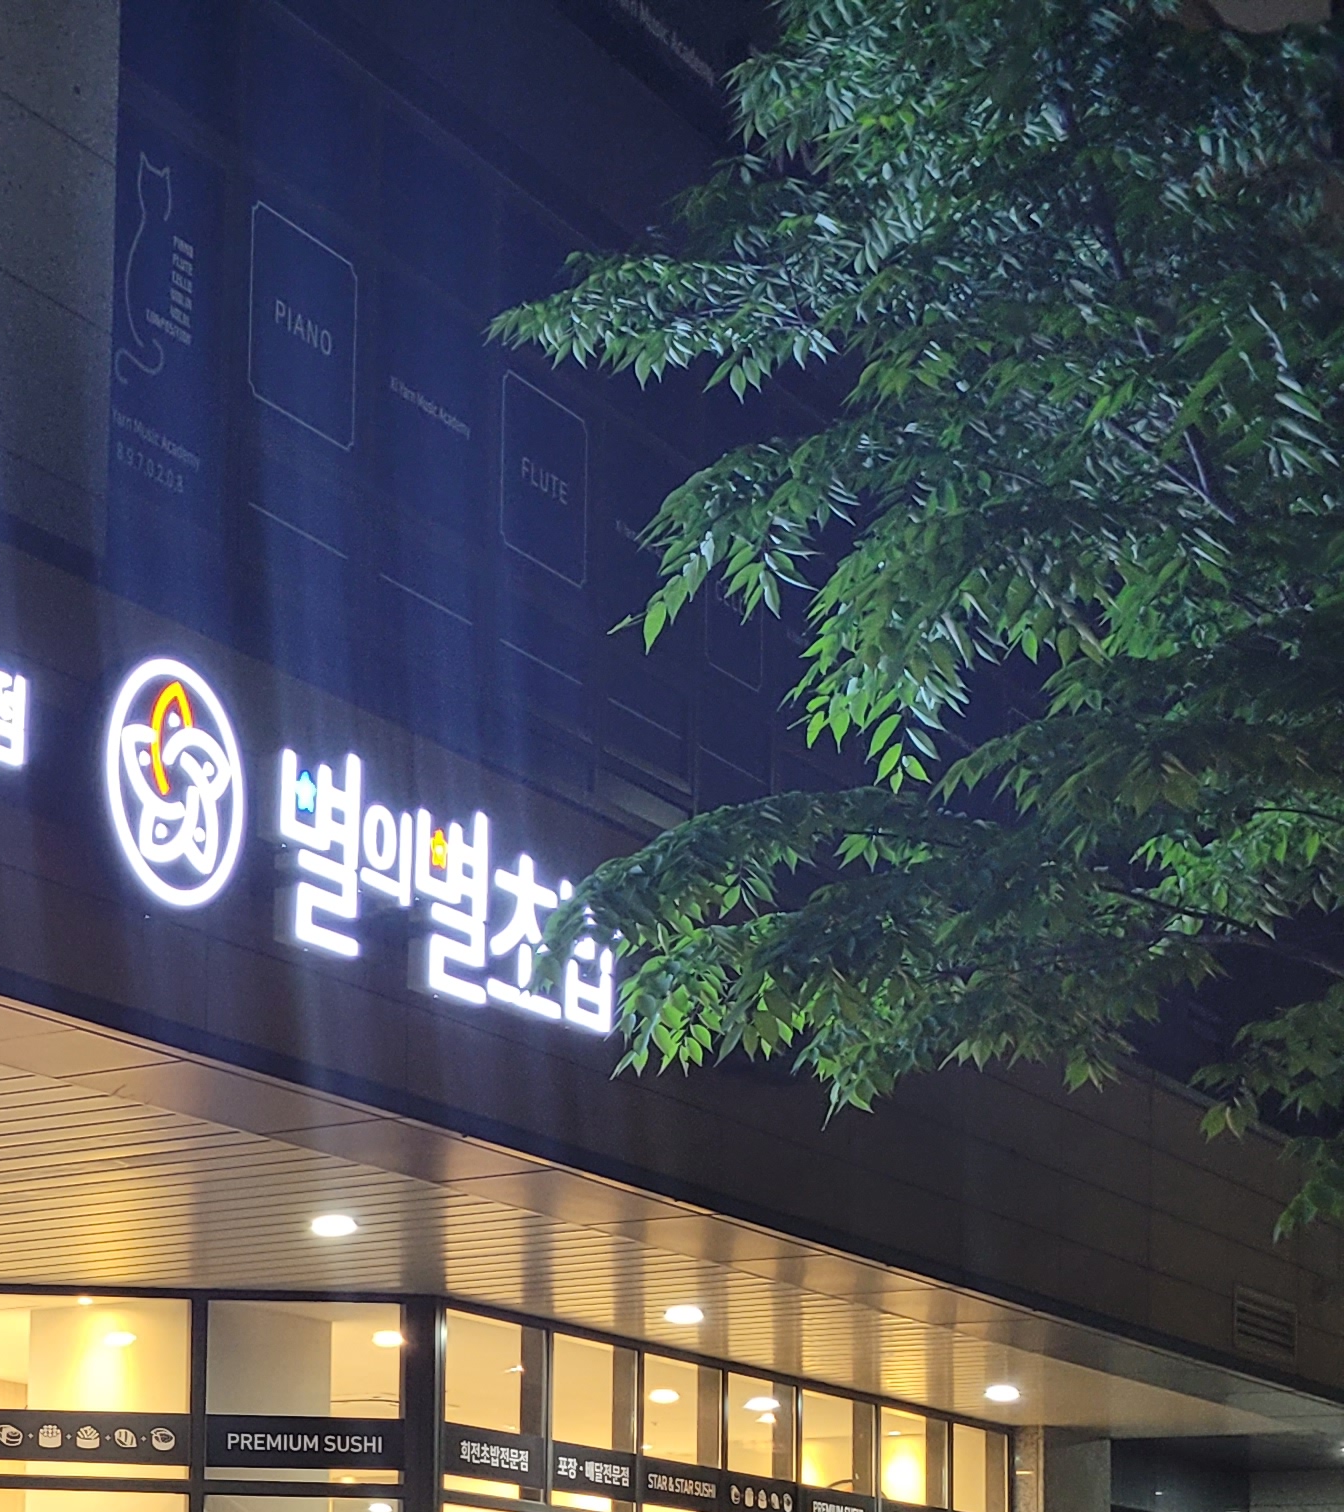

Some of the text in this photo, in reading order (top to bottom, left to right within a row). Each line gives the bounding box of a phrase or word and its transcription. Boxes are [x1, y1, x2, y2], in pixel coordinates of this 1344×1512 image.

[274, 297, 334, 357] PIANO
[520, 456, 569, 506] FLUTE
[227, 1433, 383, 1453] PREMIUM SUSHI
[460, 1440, 529, 1472] 회전초밥전문점
[557, 1456, 630, 1487] 포장 배달전문점
[648, 1473, 668, 1491] STAR
[675, 1477, 694, 1496] STAR
[694, 1480, 717, 1499] SUSHI
